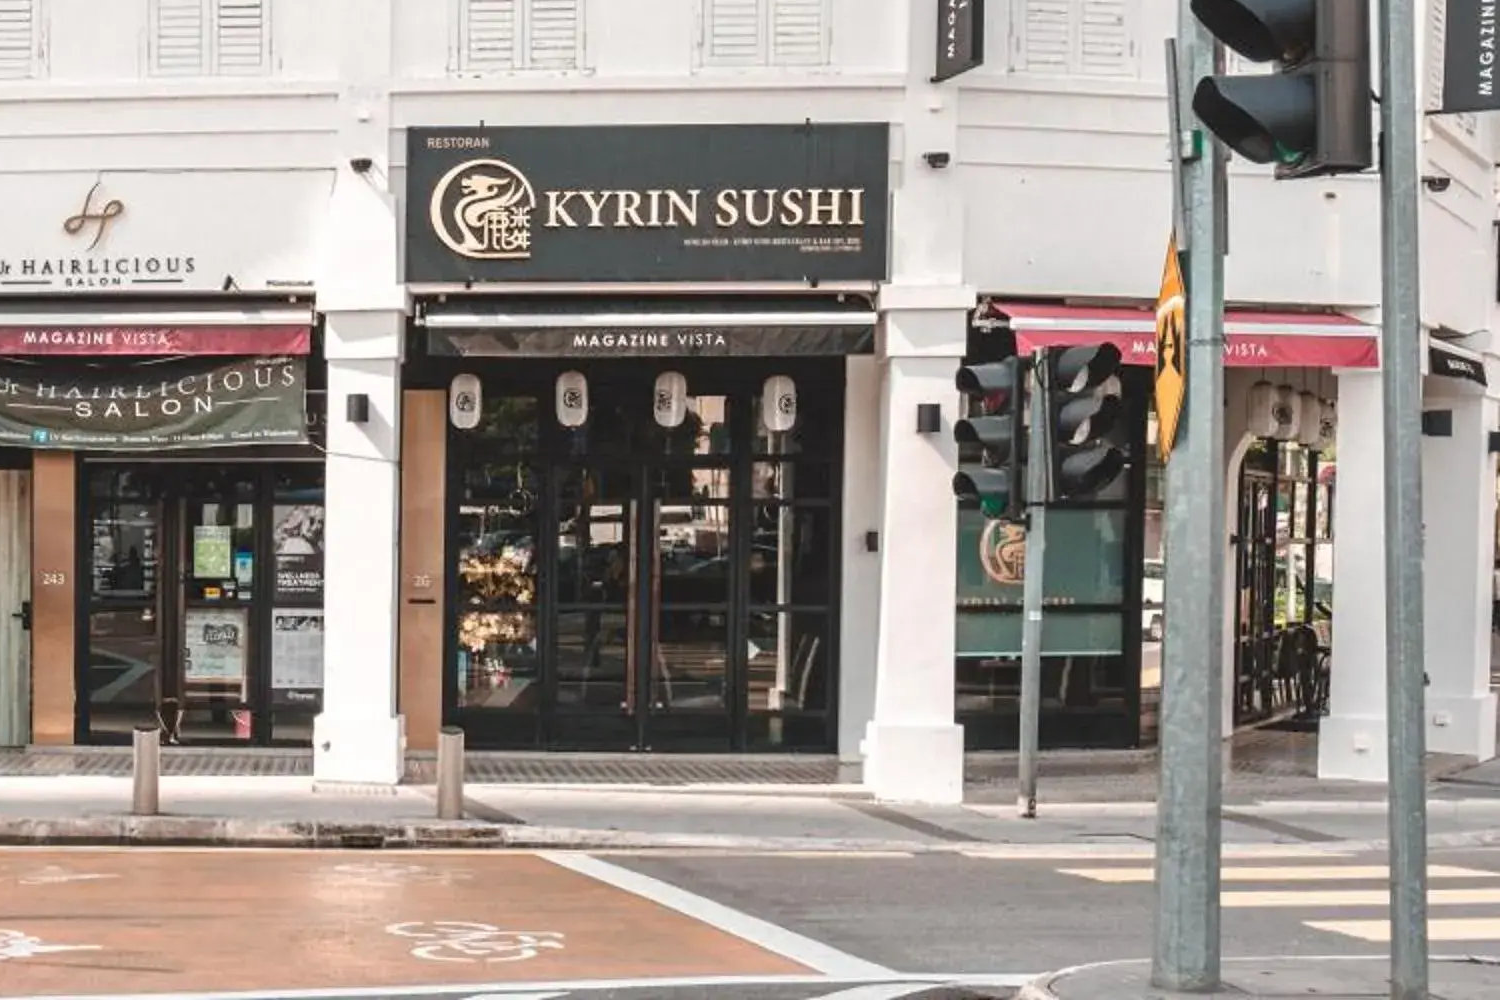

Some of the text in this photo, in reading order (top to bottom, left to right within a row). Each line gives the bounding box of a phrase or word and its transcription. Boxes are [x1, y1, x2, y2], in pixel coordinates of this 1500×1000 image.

[427, 137, 490, 149] RESTORAN
[544, 187, 865, 229] KYRIN SUSHI
[21, 257, 196, 275] HAIRLICIOUS
[65, 278, 121, 287] SALON
[23, 332, 168, 346] MAGAZINE VISTA
[573, 333, 726, 347] MAGAZINE VISTA
[1224, 343, 1267, 356] VISTA
[35, 364, 297, 399] HAIRLICIOUS
[74, 397, 213, 418] SALON
[42, 573, 65, 585] 243
